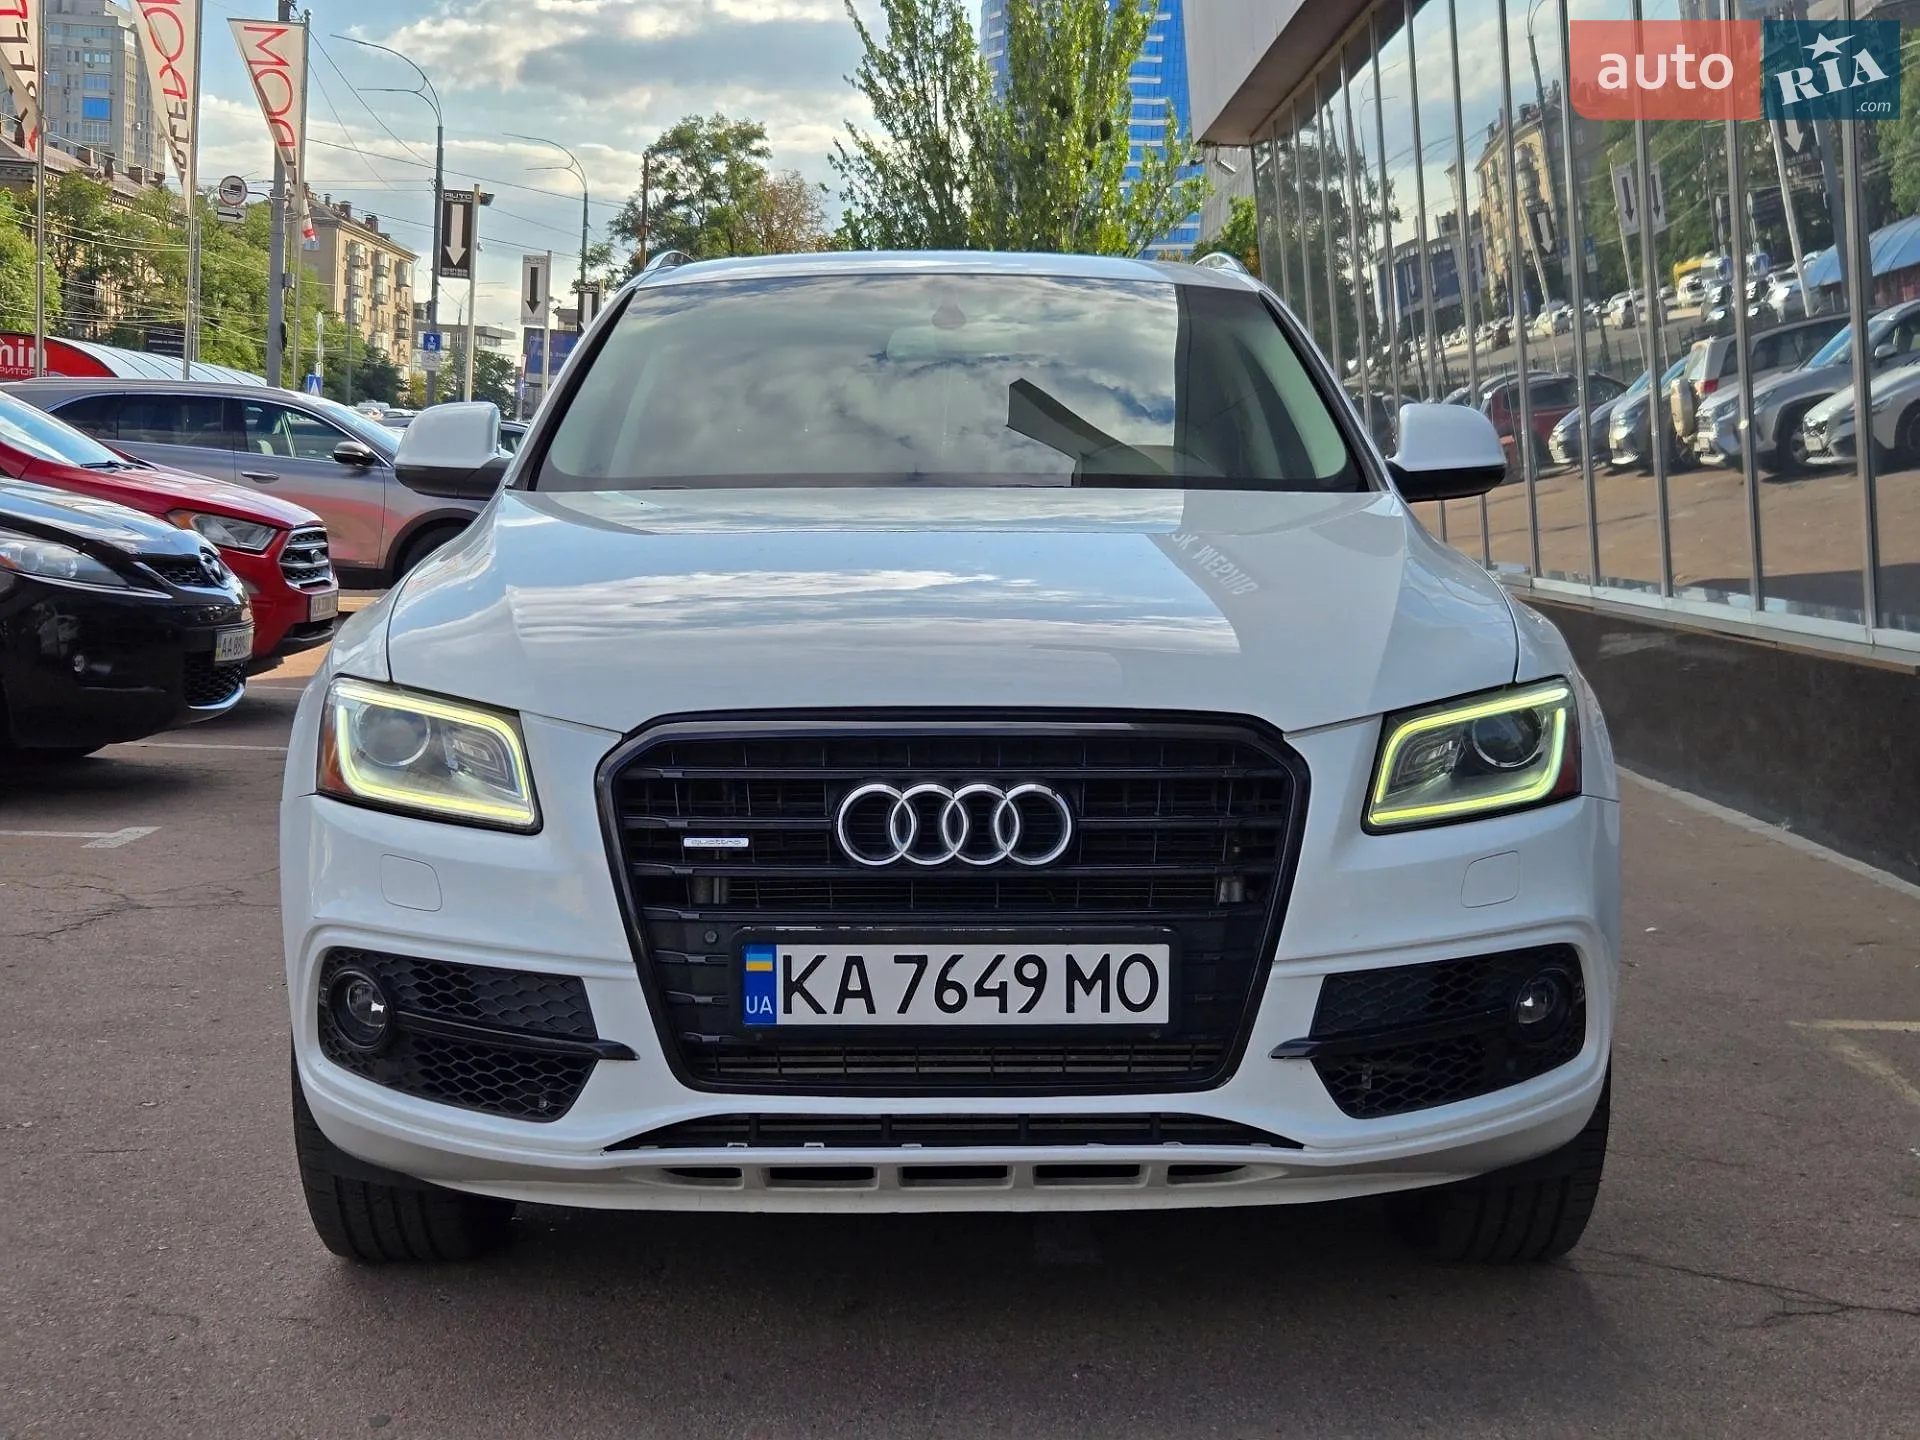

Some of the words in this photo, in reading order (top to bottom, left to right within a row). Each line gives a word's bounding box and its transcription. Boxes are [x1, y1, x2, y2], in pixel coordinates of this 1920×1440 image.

[782, 954, 877, 1015] KA
[893, 953, 1048, 1015] 7649
[1065, 952, 1160, 1014] MO
[745, 995, 773, 1015] UA
